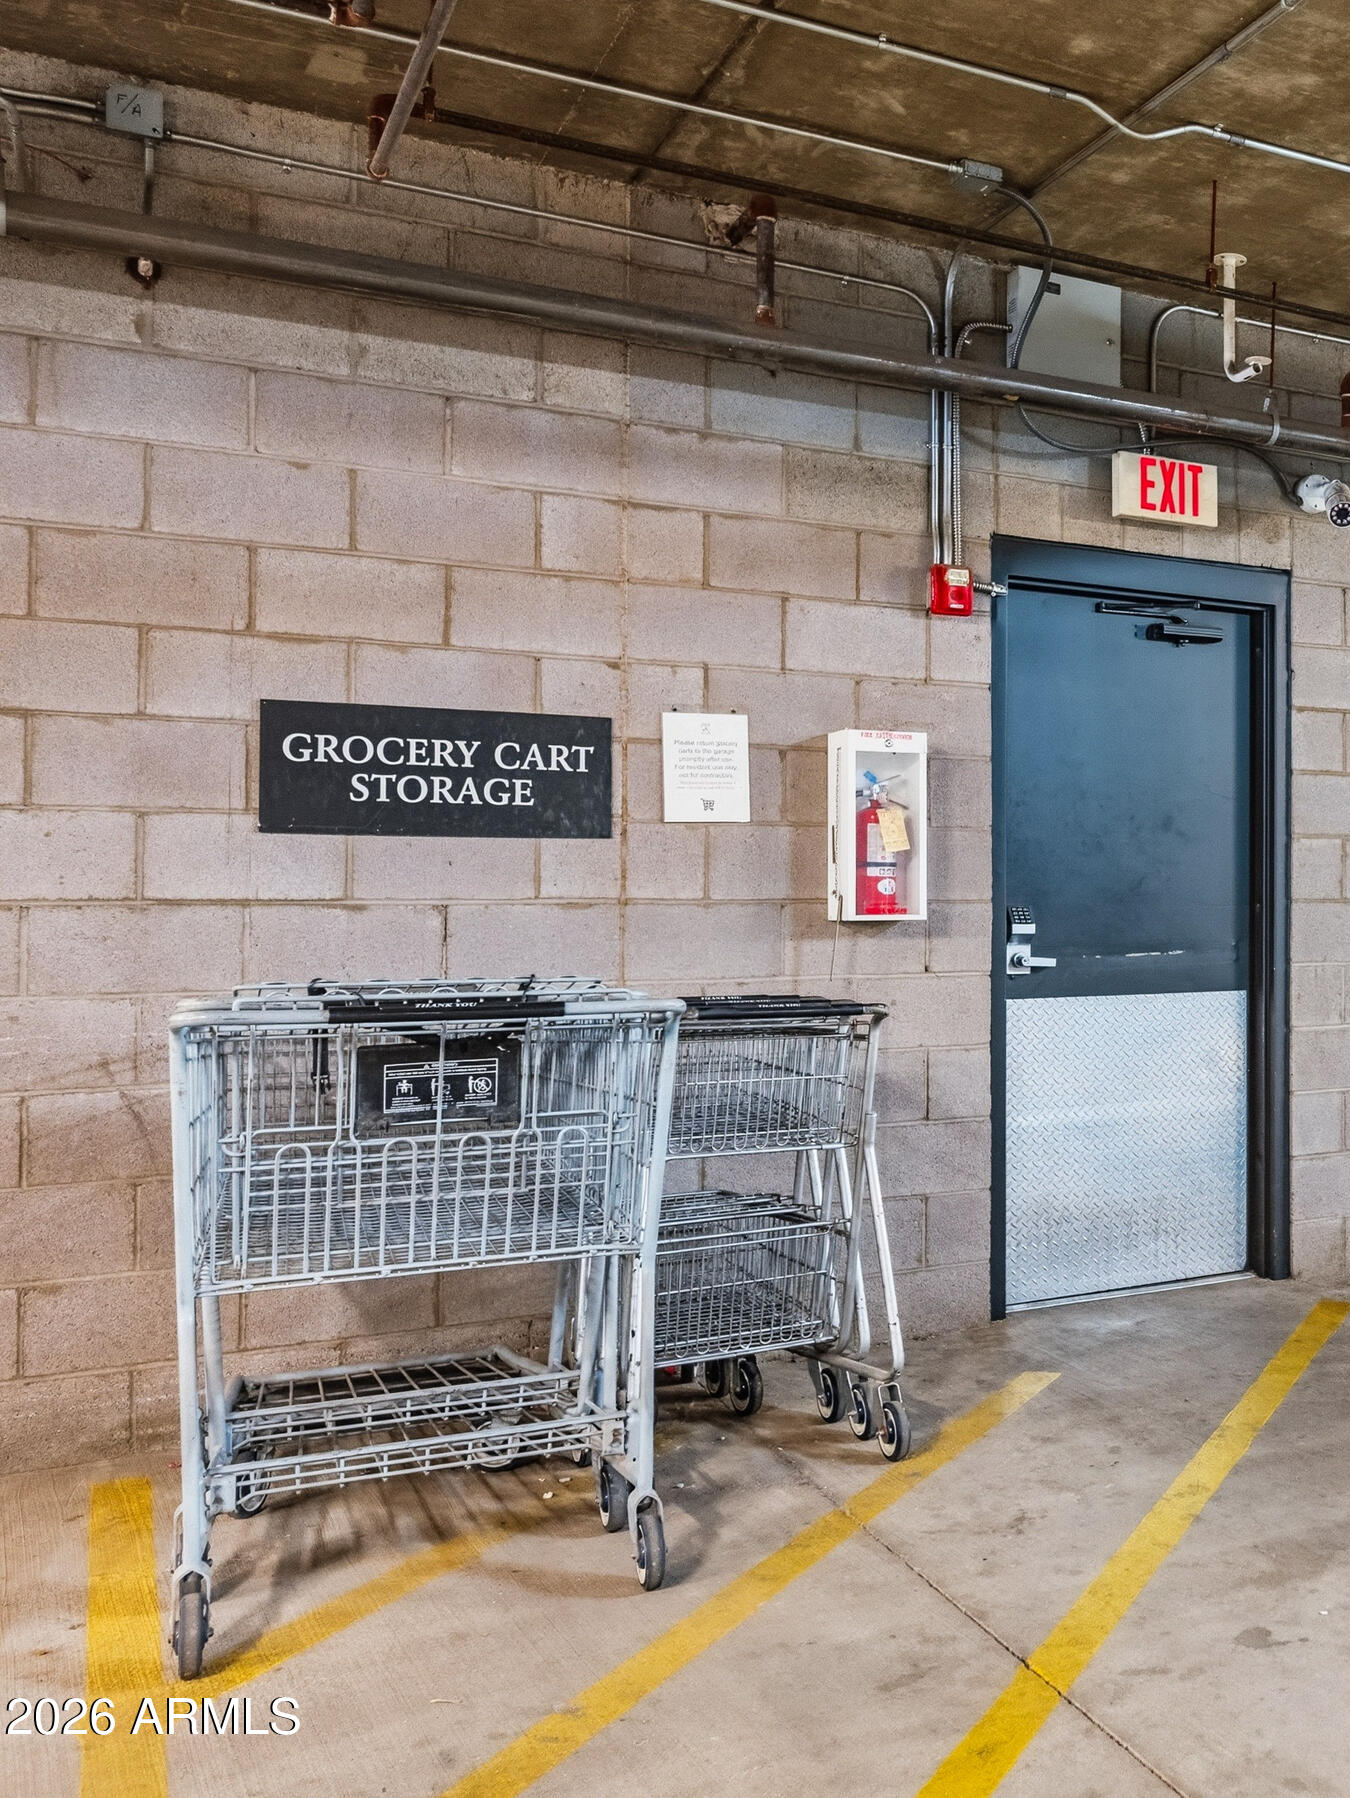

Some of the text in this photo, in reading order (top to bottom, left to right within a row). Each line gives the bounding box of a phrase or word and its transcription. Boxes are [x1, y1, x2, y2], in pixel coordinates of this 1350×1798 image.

[1140, 456, 1203, 517] EXIT
[282, 733, 594, 773] GROCERY CART
[349, 773, 535, 806] STORAGE
